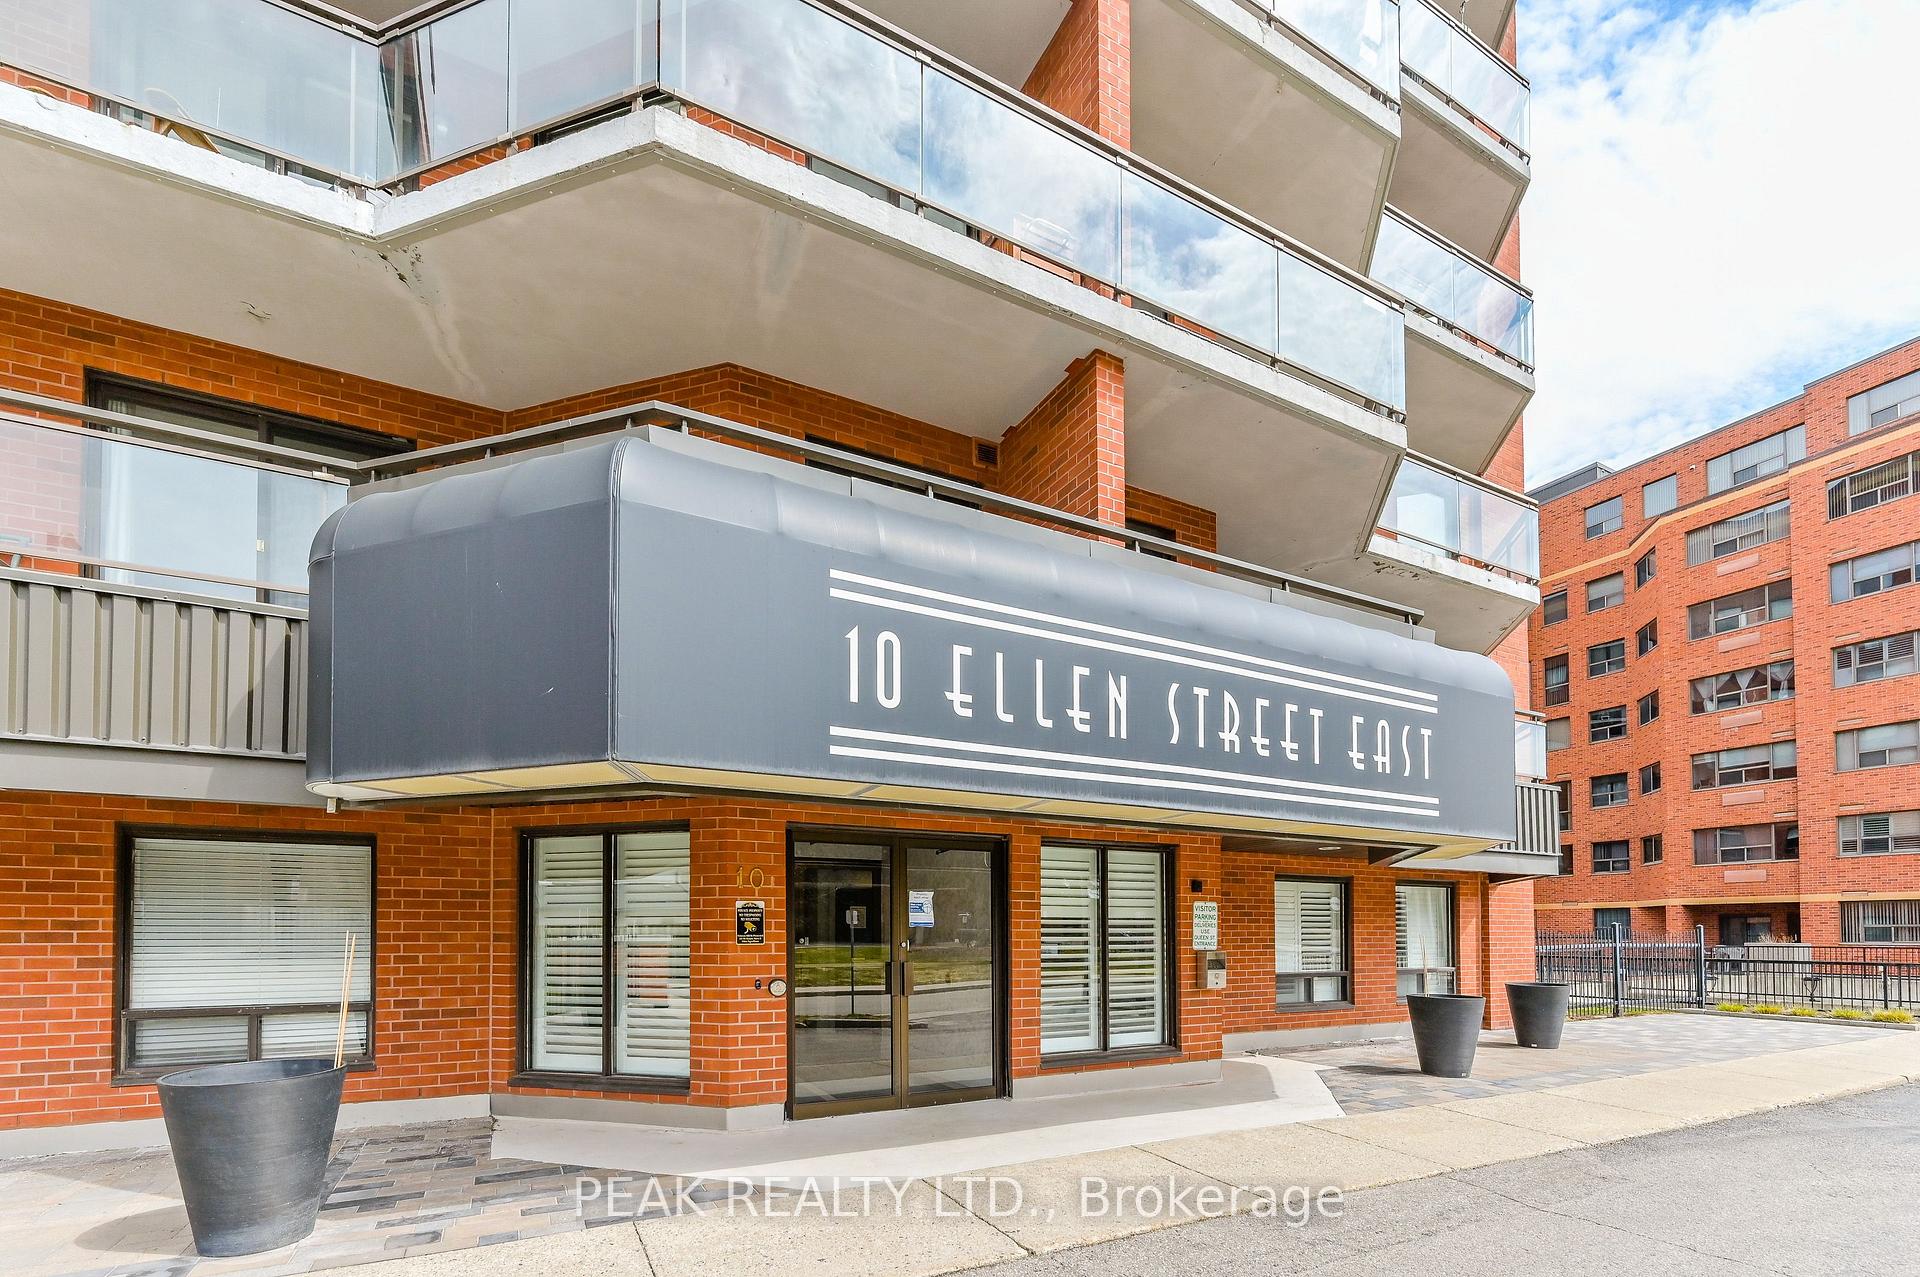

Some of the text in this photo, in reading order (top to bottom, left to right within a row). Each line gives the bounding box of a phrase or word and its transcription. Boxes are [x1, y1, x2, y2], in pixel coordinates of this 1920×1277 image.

[844, 625, 1432, 780] 10 ELLEN STREET EAST
[736, 866, 764, 889] 10
